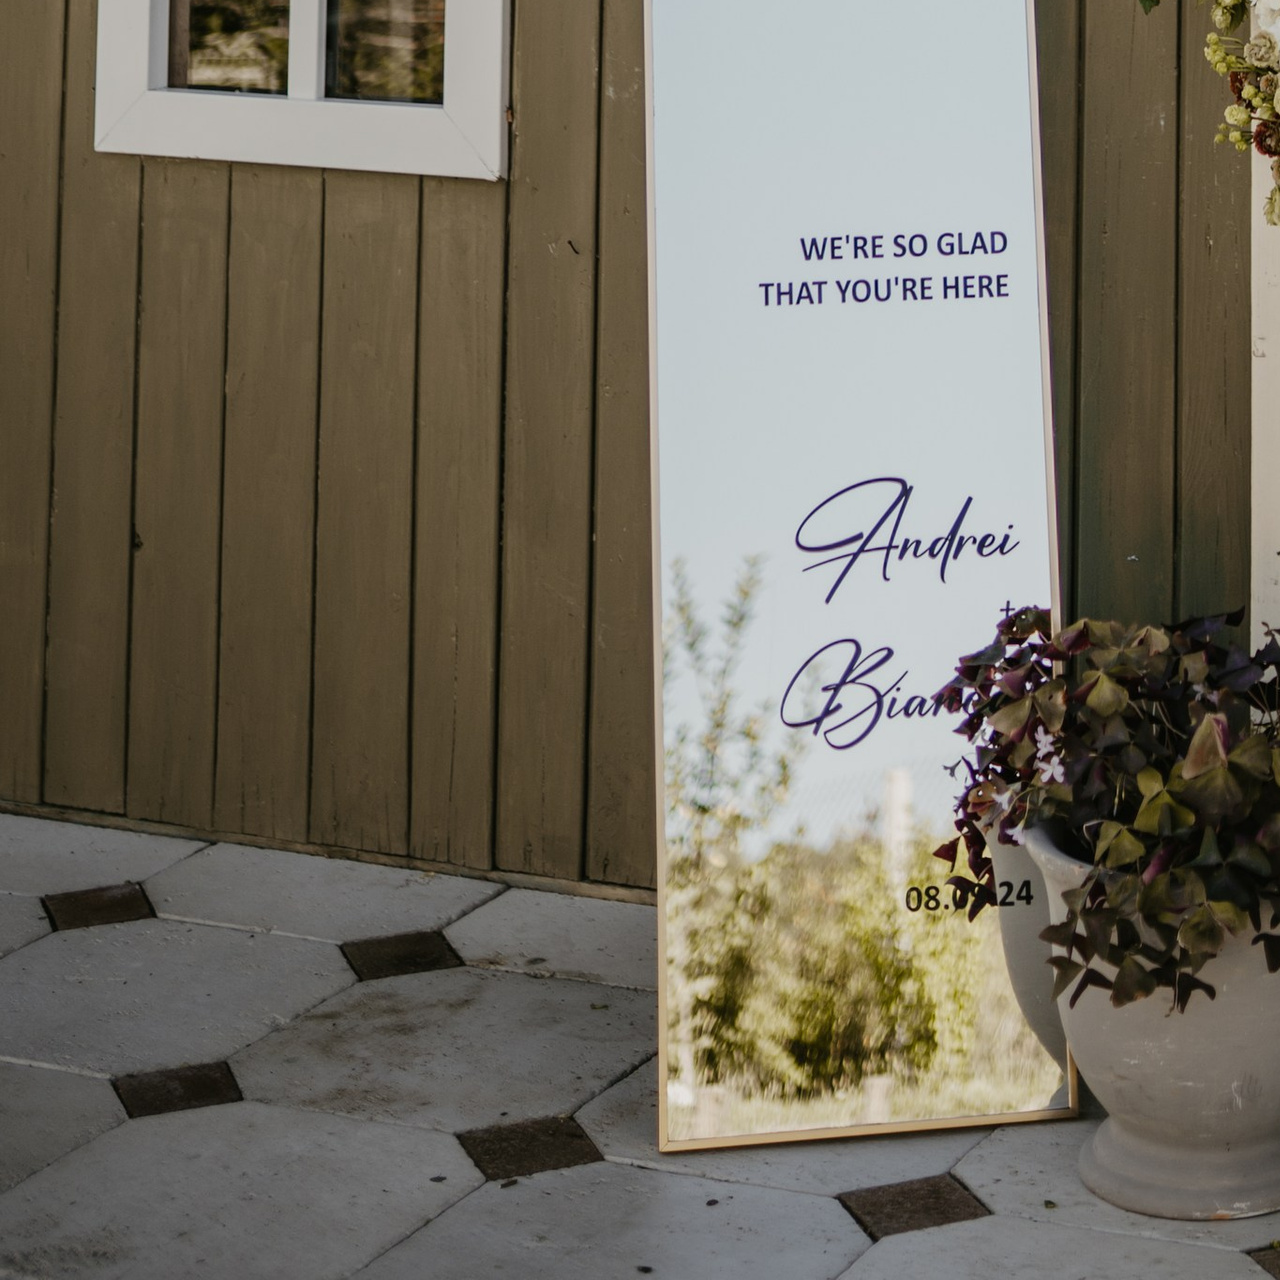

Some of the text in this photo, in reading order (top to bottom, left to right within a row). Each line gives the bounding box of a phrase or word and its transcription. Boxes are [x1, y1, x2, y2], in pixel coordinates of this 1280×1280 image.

[800, 230, 1008, 263] WE'RE SO GLAD
[759, 273, 1010, 308] THAT YOU'RE HERE
[794, 476, 1020, 605] Andrei
[779, 638, 1006, 750] Bianc
[906, 880, 1034, 912] 08.024
